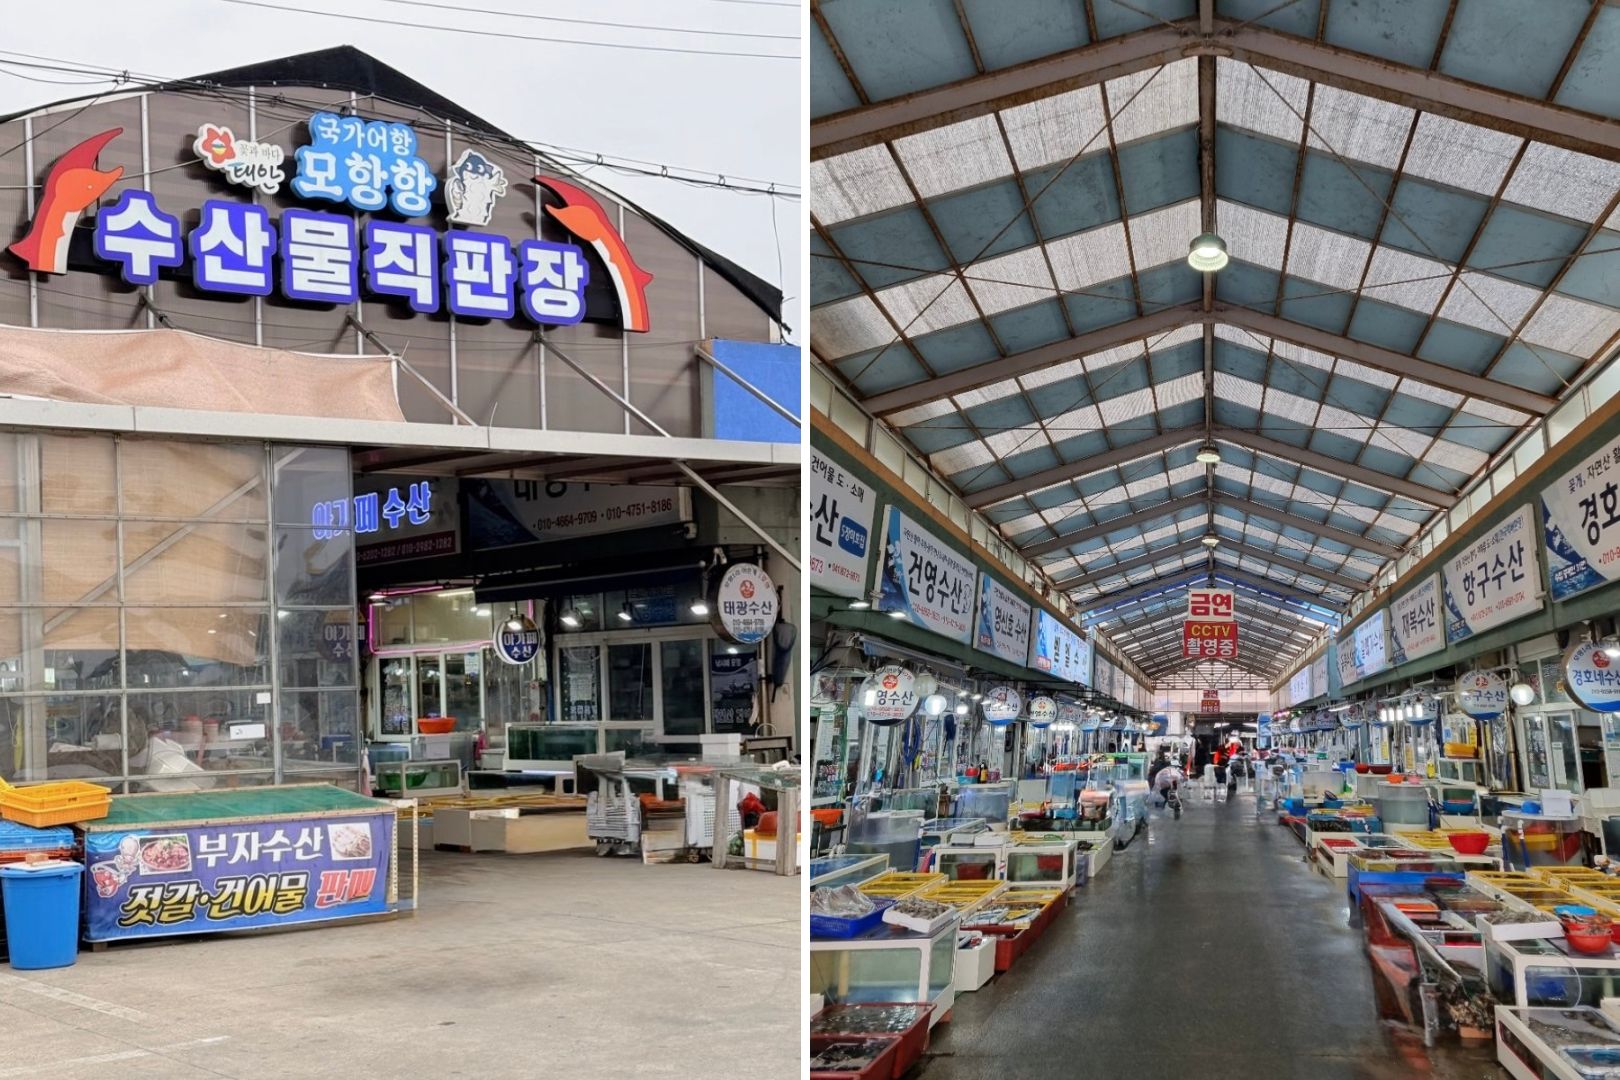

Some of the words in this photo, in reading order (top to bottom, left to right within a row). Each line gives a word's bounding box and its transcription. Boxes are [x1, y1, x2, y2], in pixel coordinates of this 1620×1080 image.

[318, 117, 413, 156] 국가어항
[239, 144, 259, 160] 꽃과
[261, 145, 281, 162] 바다
[233, 163, 281, 189] 태안
[304, 152, 432, 212] 모항항
[104, 197, 584, 318] 수산물직판장
[811, 455, 835, 483] 건어물
[1587, 452, 1610, 478] 자연산
[383, 481, 431, 528] 수산
[537, 510, 598, 531] 010-4664-9709
[606, 498, 672, 520] 010-4751-8186
[810, 494, 839, 547] 산
[908, 551, 963, 615] 건영수산
[1463, 540, 1525, 606] 항구수산
[723, 600, 773, 616] 태광수산
[1190, 593, 1232, 617] 금연
[503, 632, 537, 647] 아가페
[1191, 624, 1231, 637] CCTV
[511, 646, 532, 659] 수산
[1186, 637, 1234, 656] 촬영중
[197, 826, 324, 868] 부자수산
[315, 867, 377, 909] 판매
